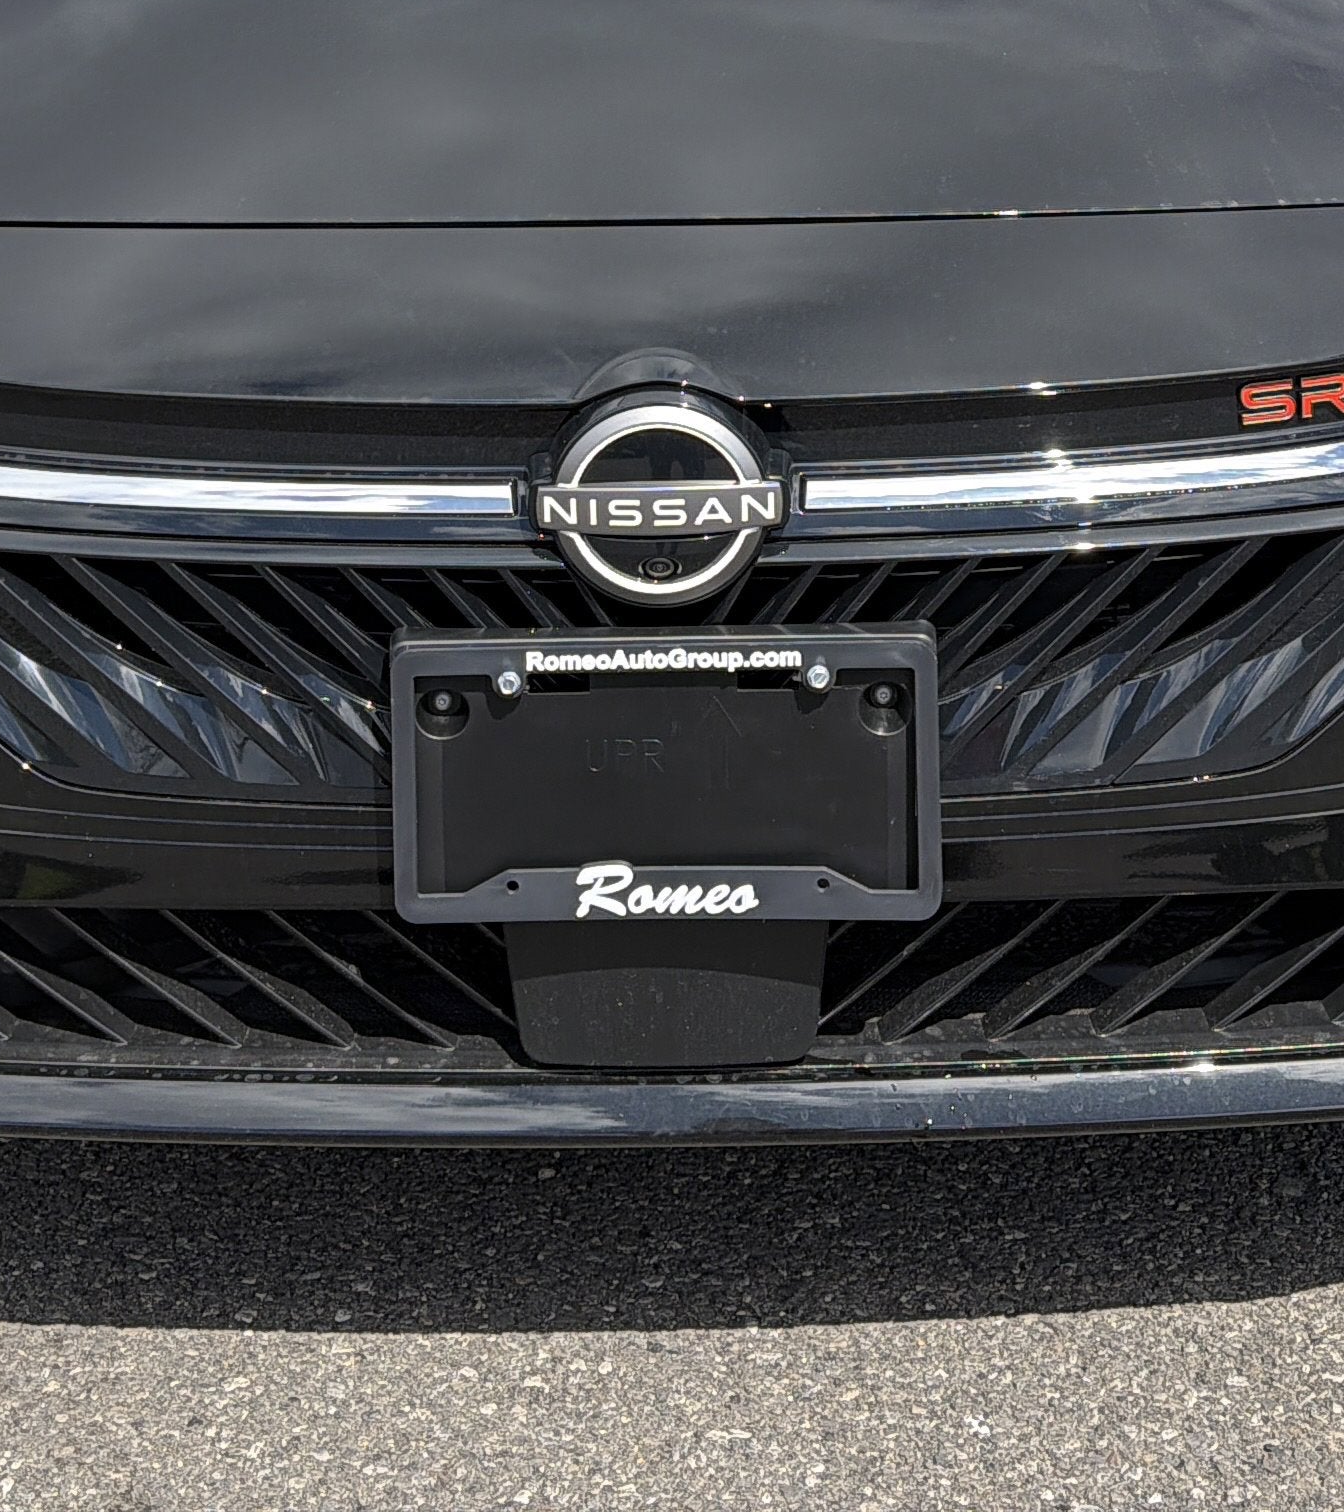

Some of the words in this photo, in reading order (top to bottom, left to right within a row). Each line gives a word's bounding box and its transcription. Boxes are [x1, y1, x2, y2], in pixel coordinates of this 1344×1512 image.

[543, 491, 775, 527] NISSAN
[525, 648, 802, 672] RomeoAutoGroup.com
[575, 863, 760, 918] Romeo
